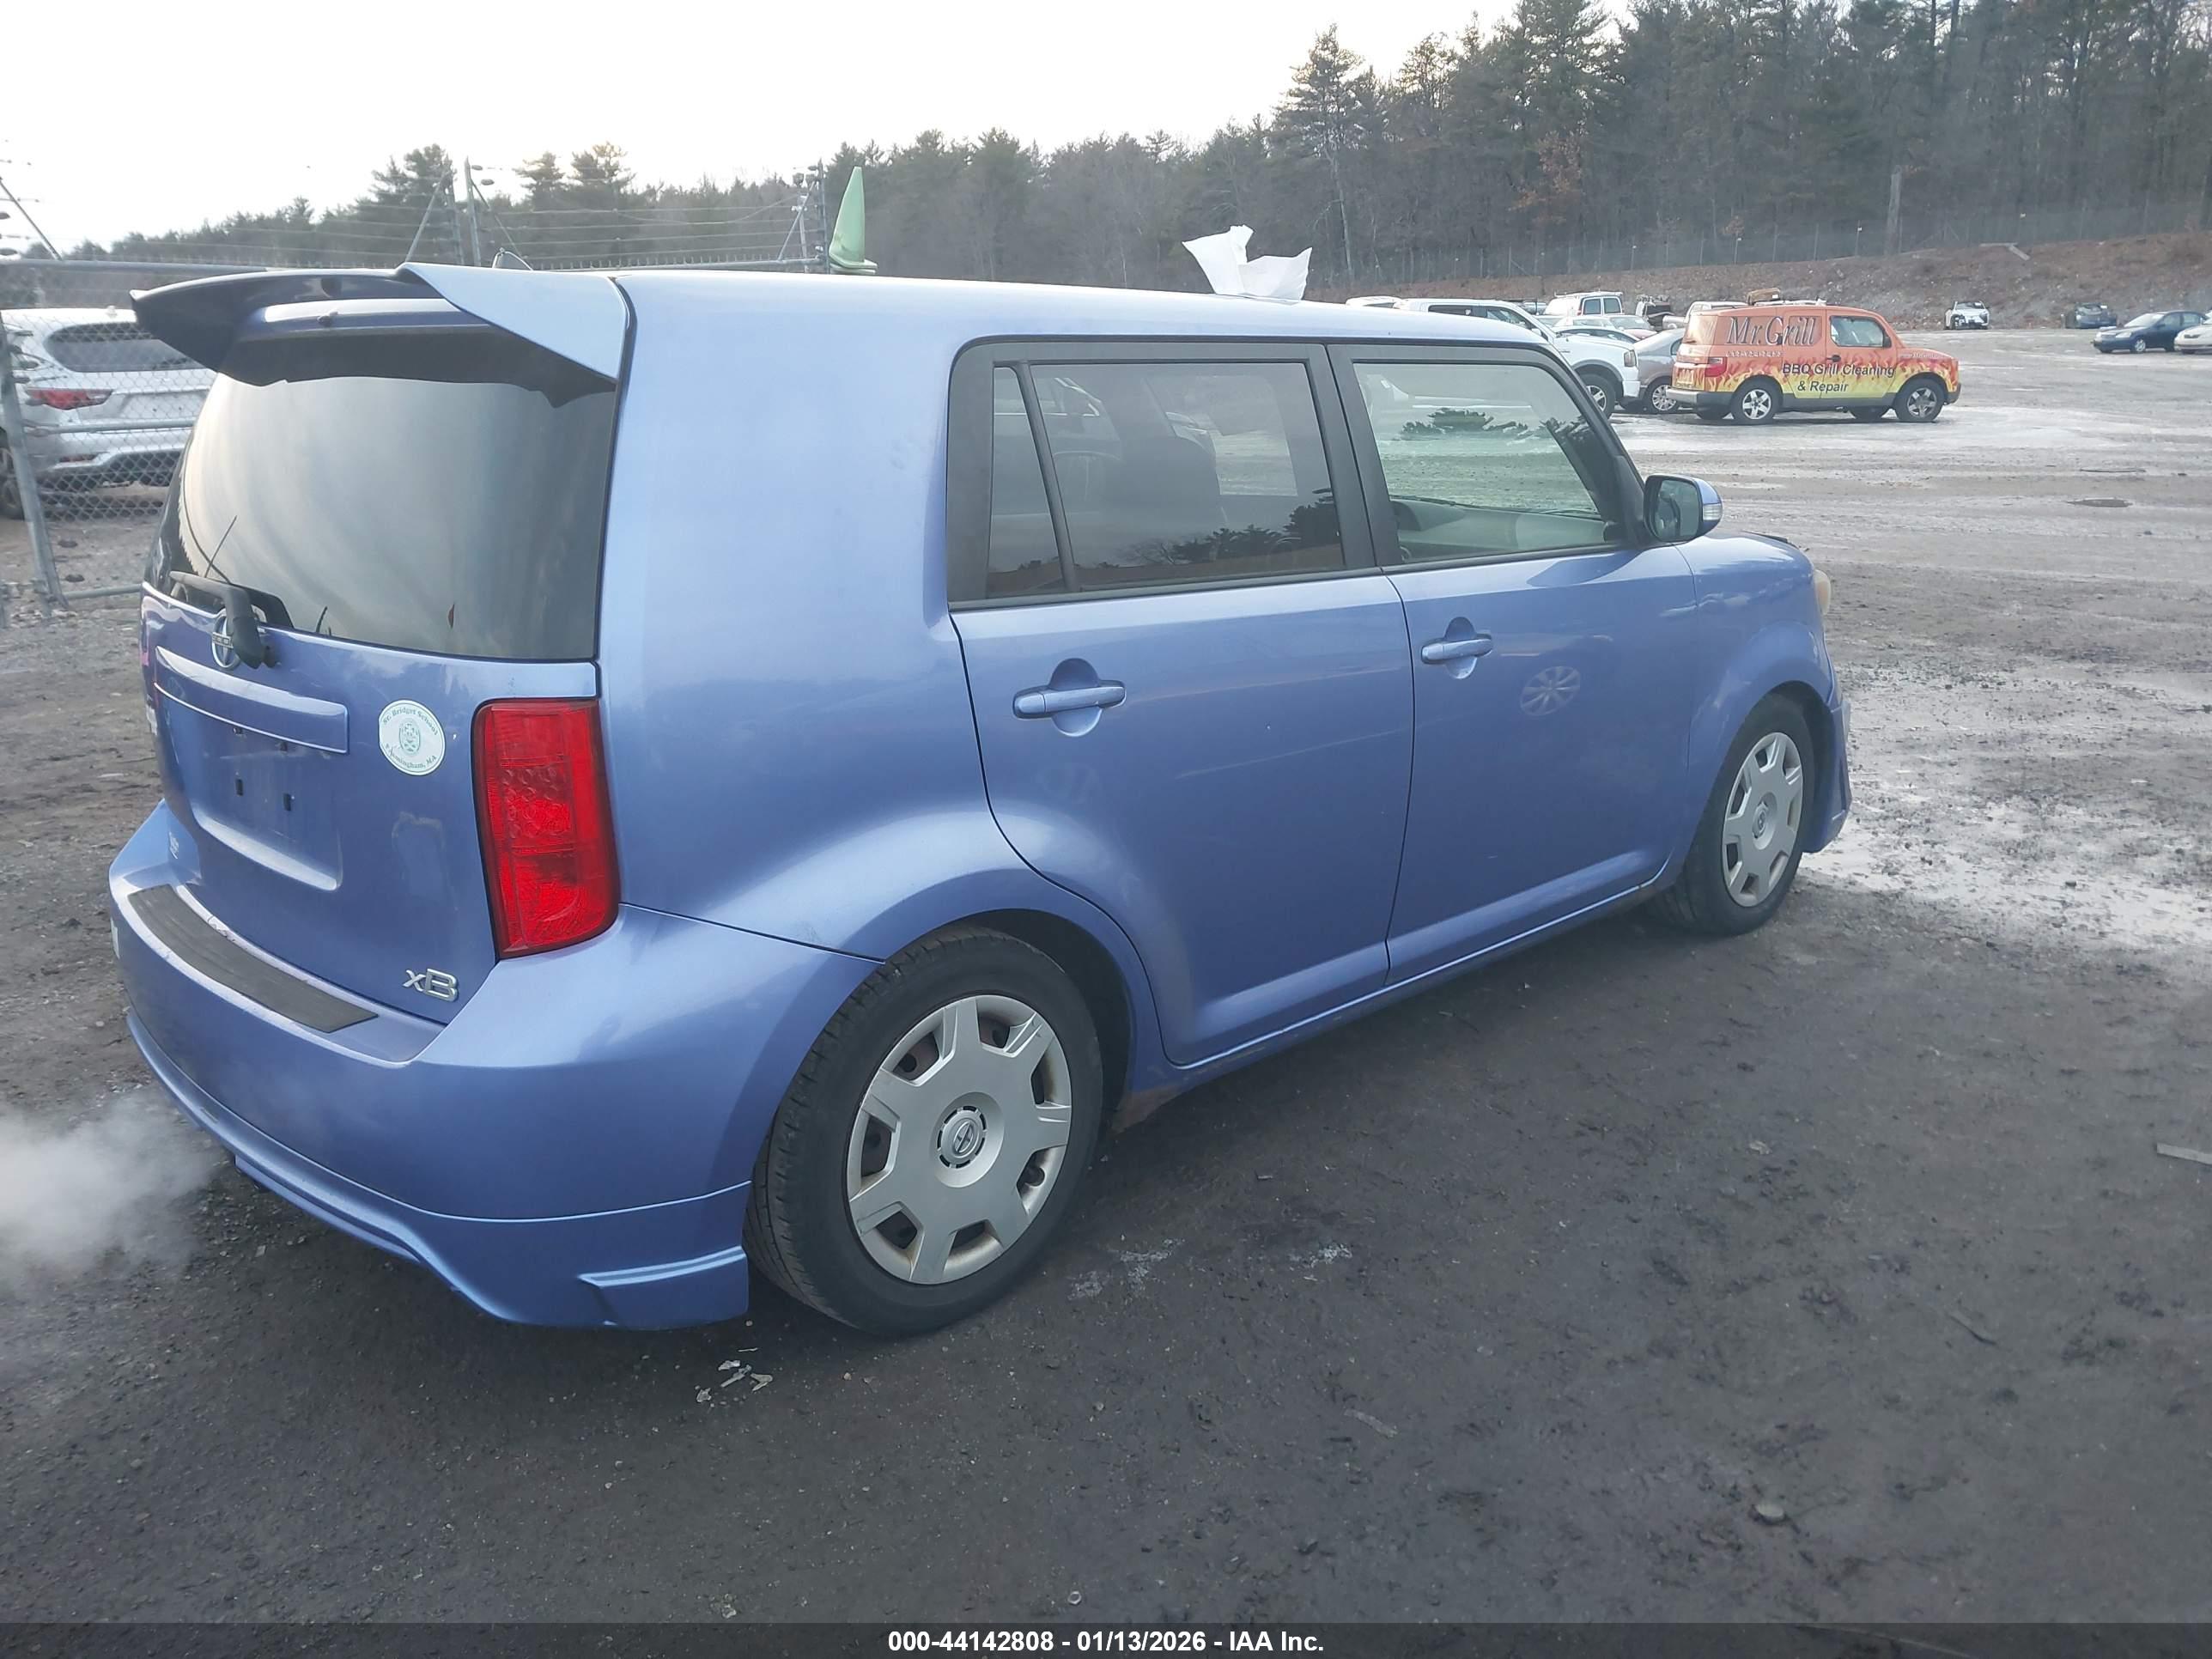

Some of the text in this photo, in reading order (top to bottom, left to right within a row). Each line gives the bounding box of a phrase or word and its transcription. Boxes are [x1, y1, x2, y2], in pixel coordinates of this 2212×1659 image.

[1765, 315, 1817, 346] Grill
[1782, 363, 1895, 378] BBQ Grill Cleaning
[1797, 380, 1849, 393] & Repair
[392, 708, 416, 716] Bridget
[426, 755, 436, 765] MA
[403, 968, 459, 1002] xB
